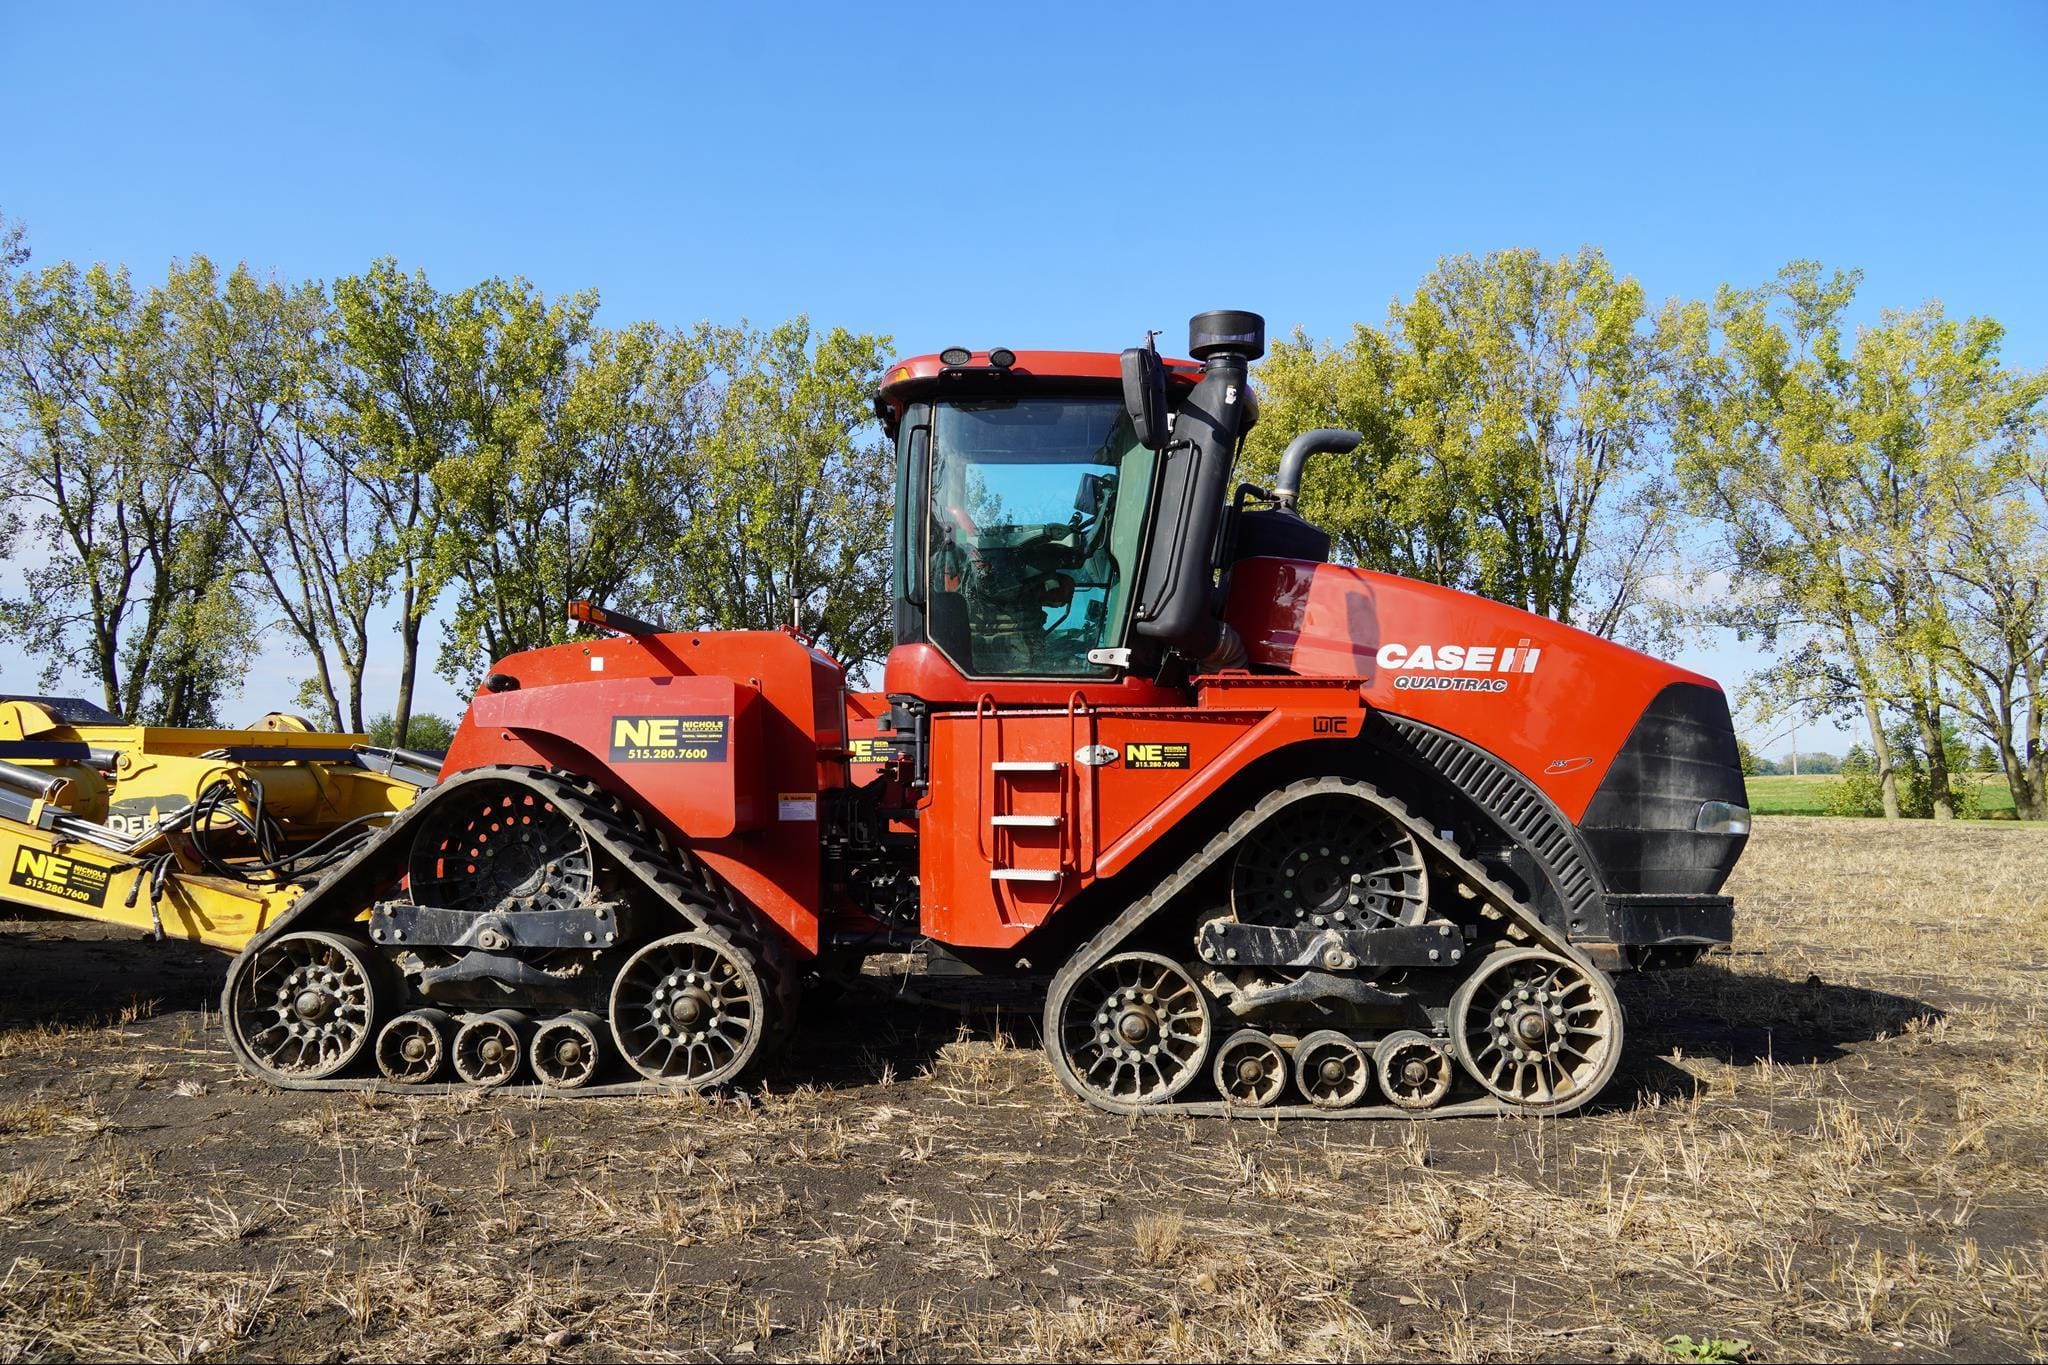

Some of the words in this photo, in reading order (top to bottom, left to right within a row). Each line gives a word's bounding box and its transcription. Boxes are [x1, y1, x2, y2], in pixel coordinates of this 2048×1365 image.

[1376, 643, 1497, 671] CASE
[1394, 675, 1508, 693] QUADTRAC
[614, 719, 679, 747] NE
[628, 748, 708, 759] 515.280.7600
[1127, 745, 1162, 761] NE
[16, 849, 72, 885] NE
[73, 864, 107, 878] NICHOLS
[25, 877, 90, 901] 515.280.7600
